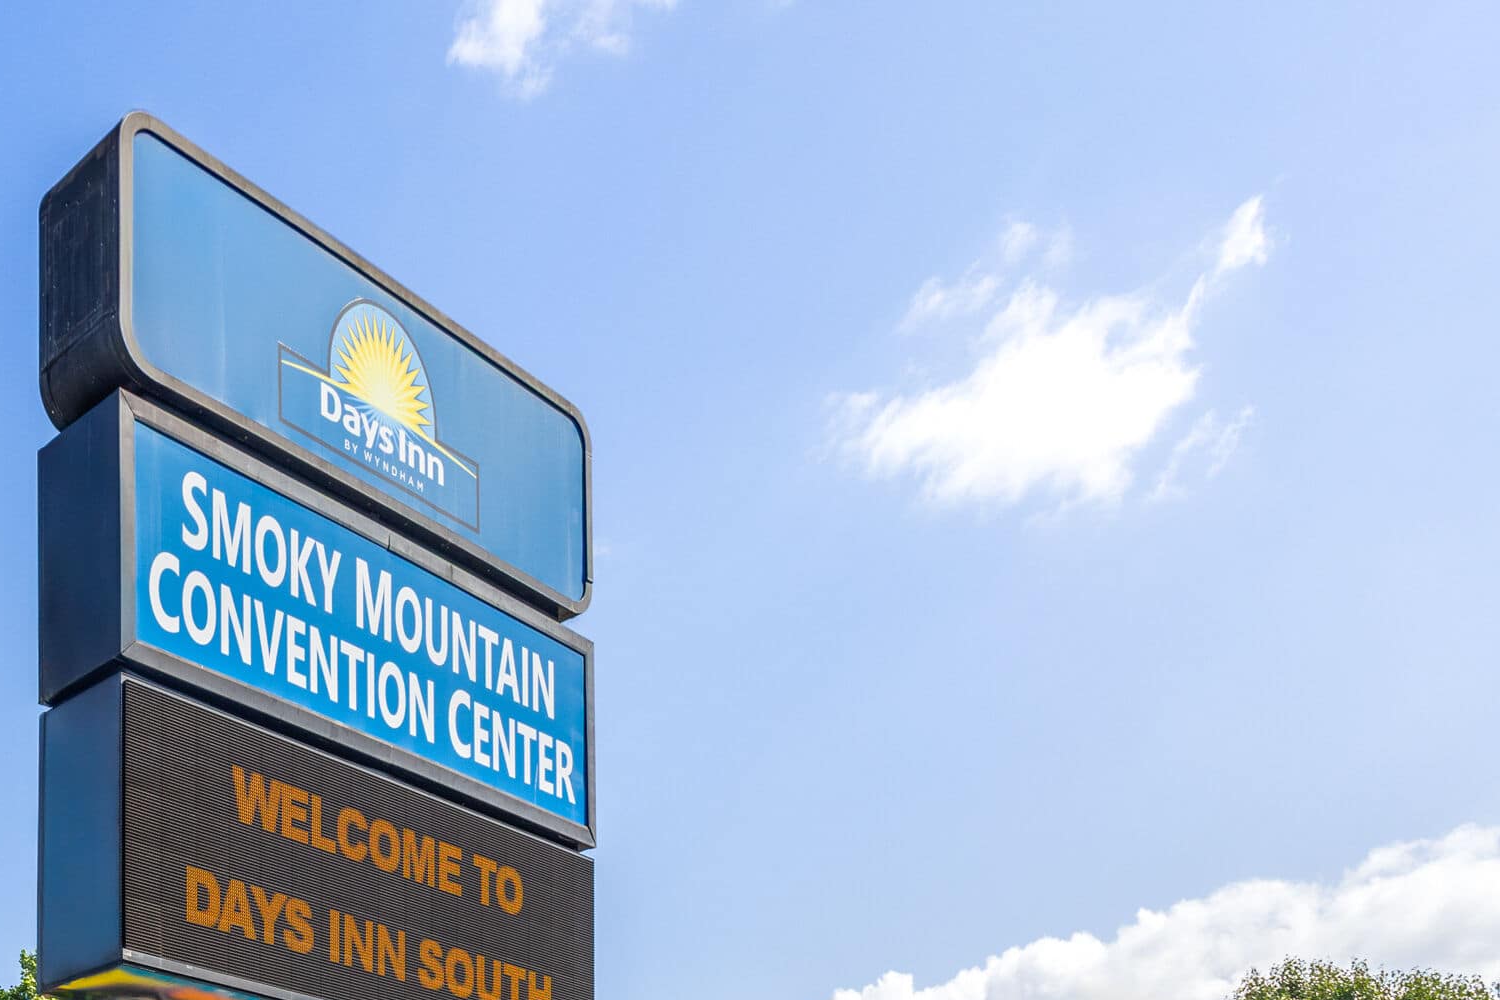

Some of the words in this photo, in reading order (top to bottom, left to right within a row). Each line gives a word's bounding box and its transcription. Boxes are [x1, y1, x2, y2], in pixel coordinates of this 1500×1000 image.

[320, 381, 393, 455] Days
[399, 429, 445, 487] Inn
[344, 439, 358, 455] BY
[364, 451, 424, 493] WYNDHAM
[182, 471, 341, 614] SMOKY
[356, 557, 554, 720] MOUNTAIN
[148, 551, 435, 744] CONVENTION
[448, 690, 576, 804] CENTER
[232, 764, 462, 896] WELCOME
[473, 853, 524, 916] TO
[186, 865, 314, 955] DAYS
[329, 909, 405, 981] INN
